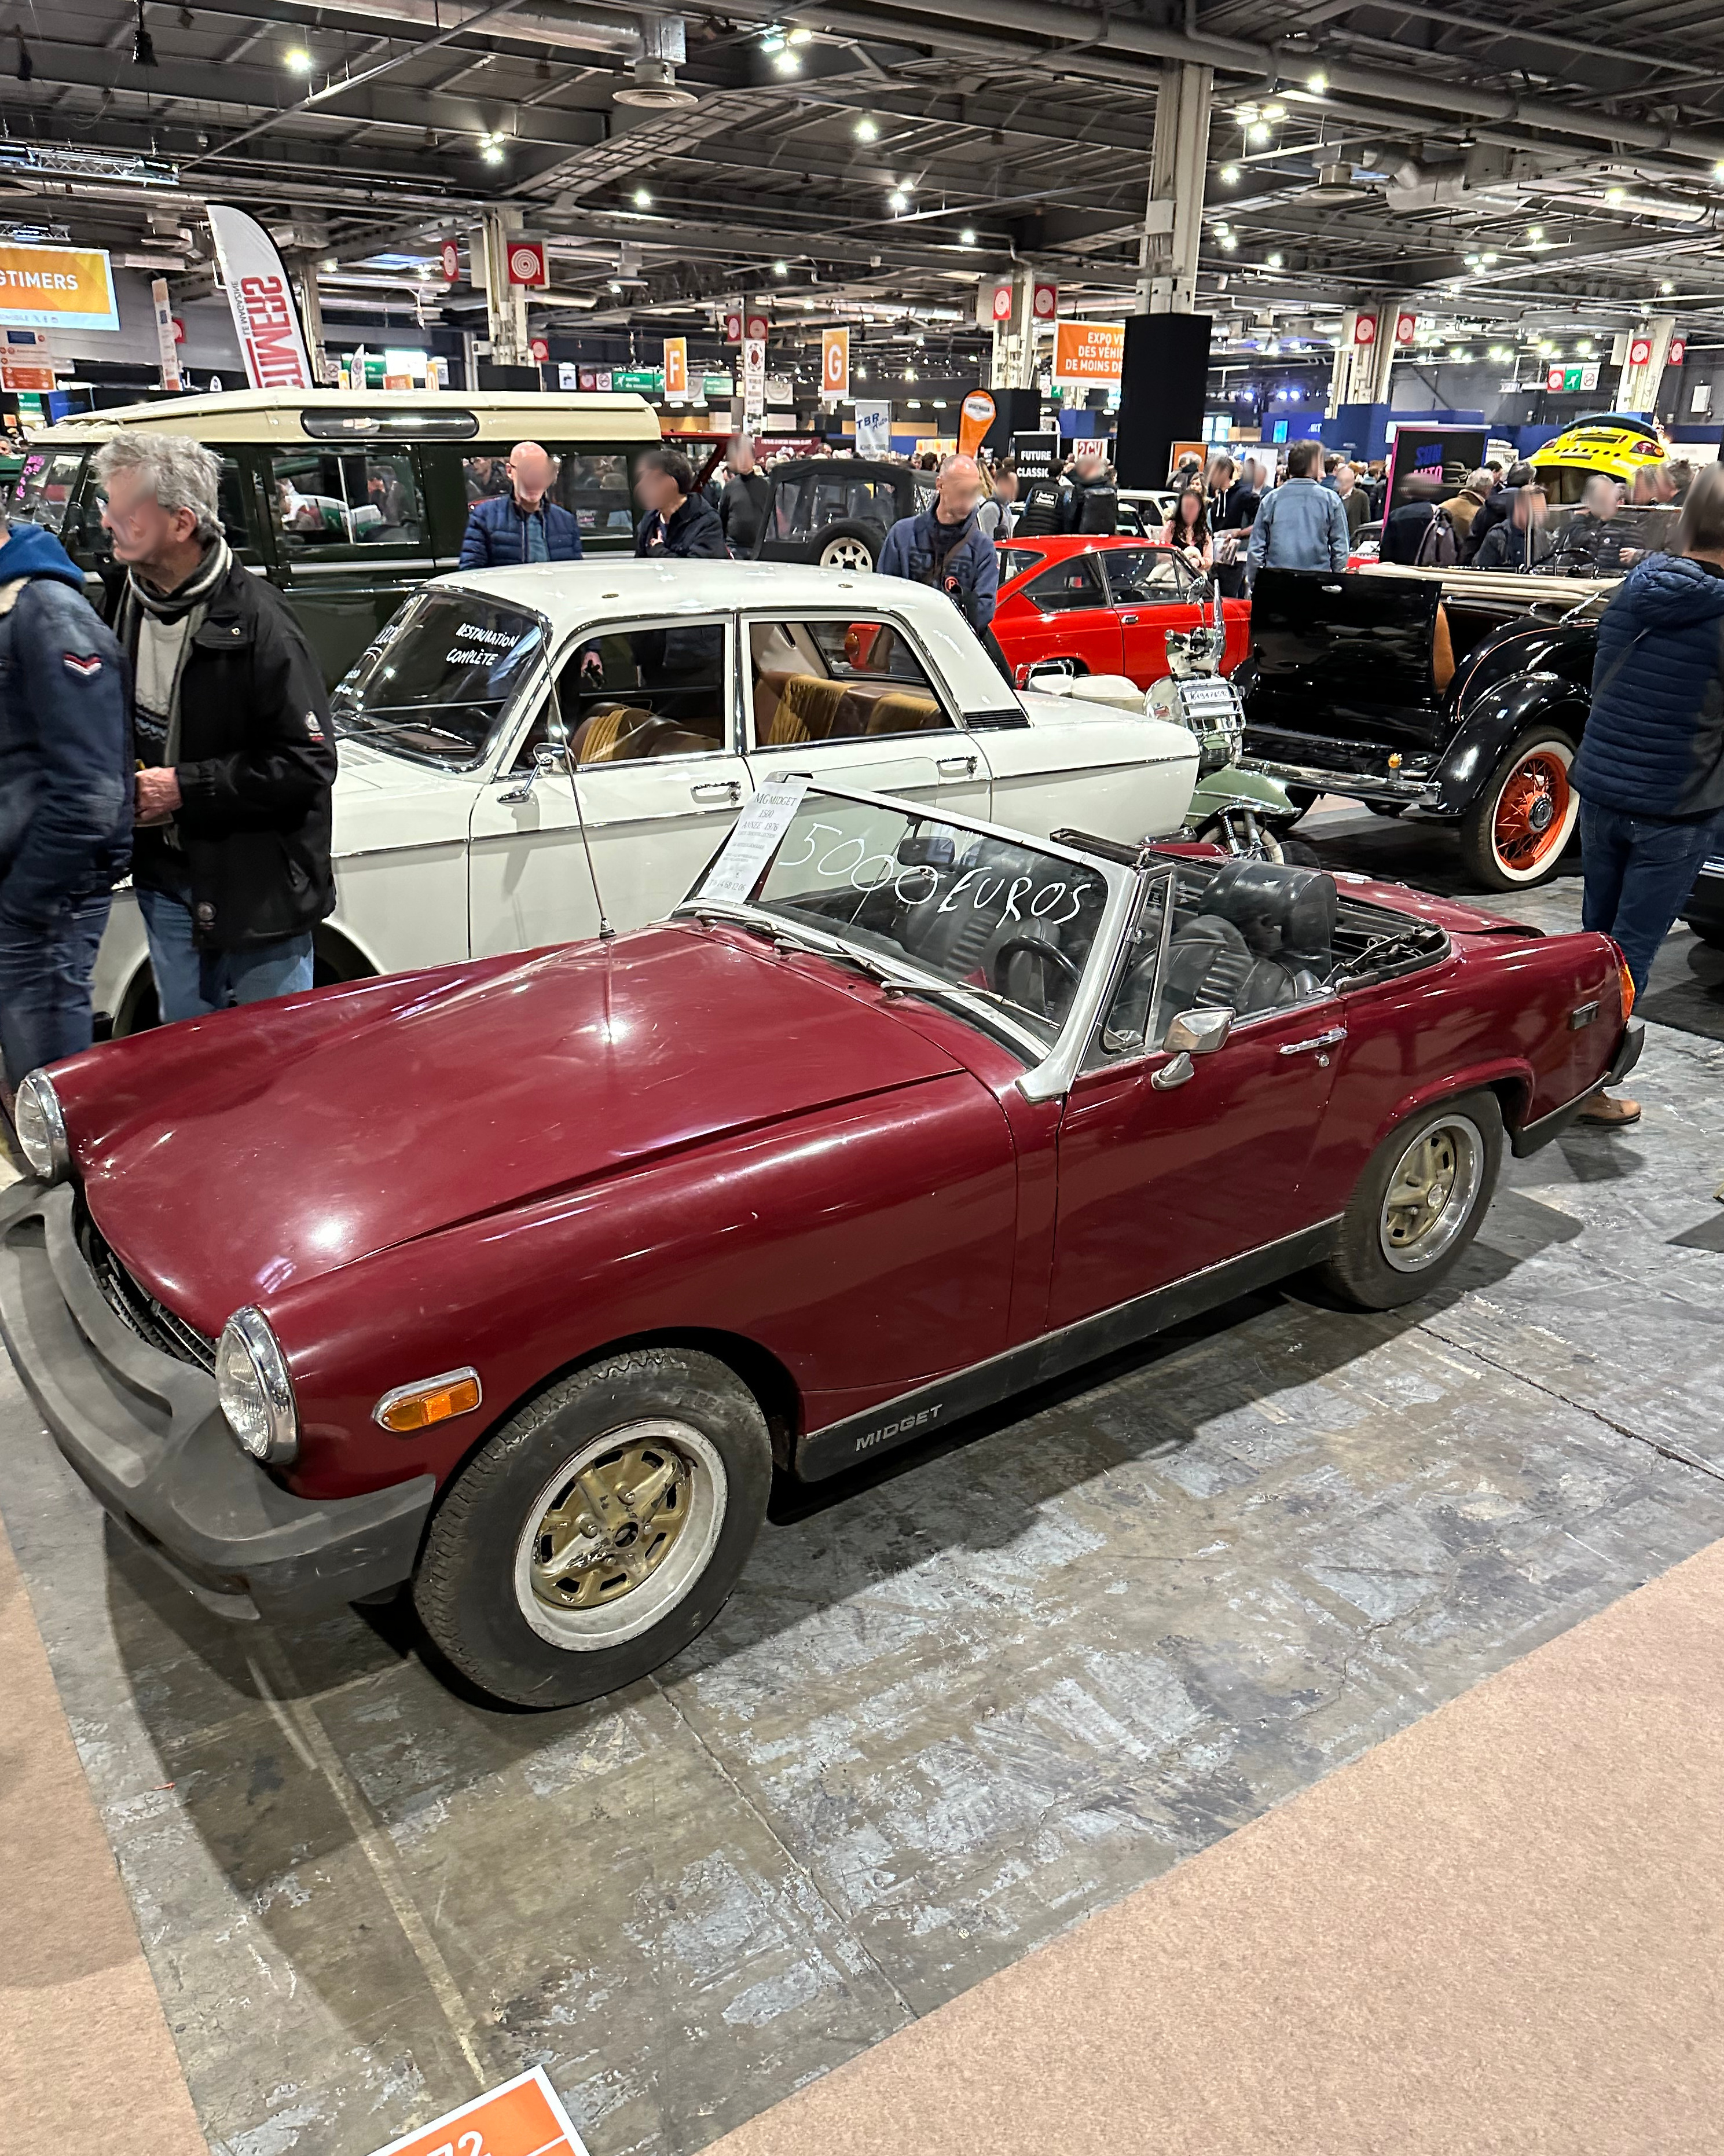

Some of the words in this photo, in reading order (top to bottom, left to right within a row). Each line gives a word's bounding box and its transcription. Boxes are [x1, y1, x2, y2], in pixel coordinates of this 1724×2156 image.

[1078, 345, 1096, 358] DES
[670, 350, 680, 384] F
[828, 344, 842, 381] G
[1065, 358, 1078, 371] DE
[1080, 359, 1110, 372] MOINS
[856, 413, 879, 430] TBR
[1021, 450, 1051, 461] FUTURE
[771, 795, 798, 806] MIDGET
[778, 823, 939, 904] 5000
[937, 866, 1091, 929] EUROS
[855, 1403, 943, 1451] MIDGET
